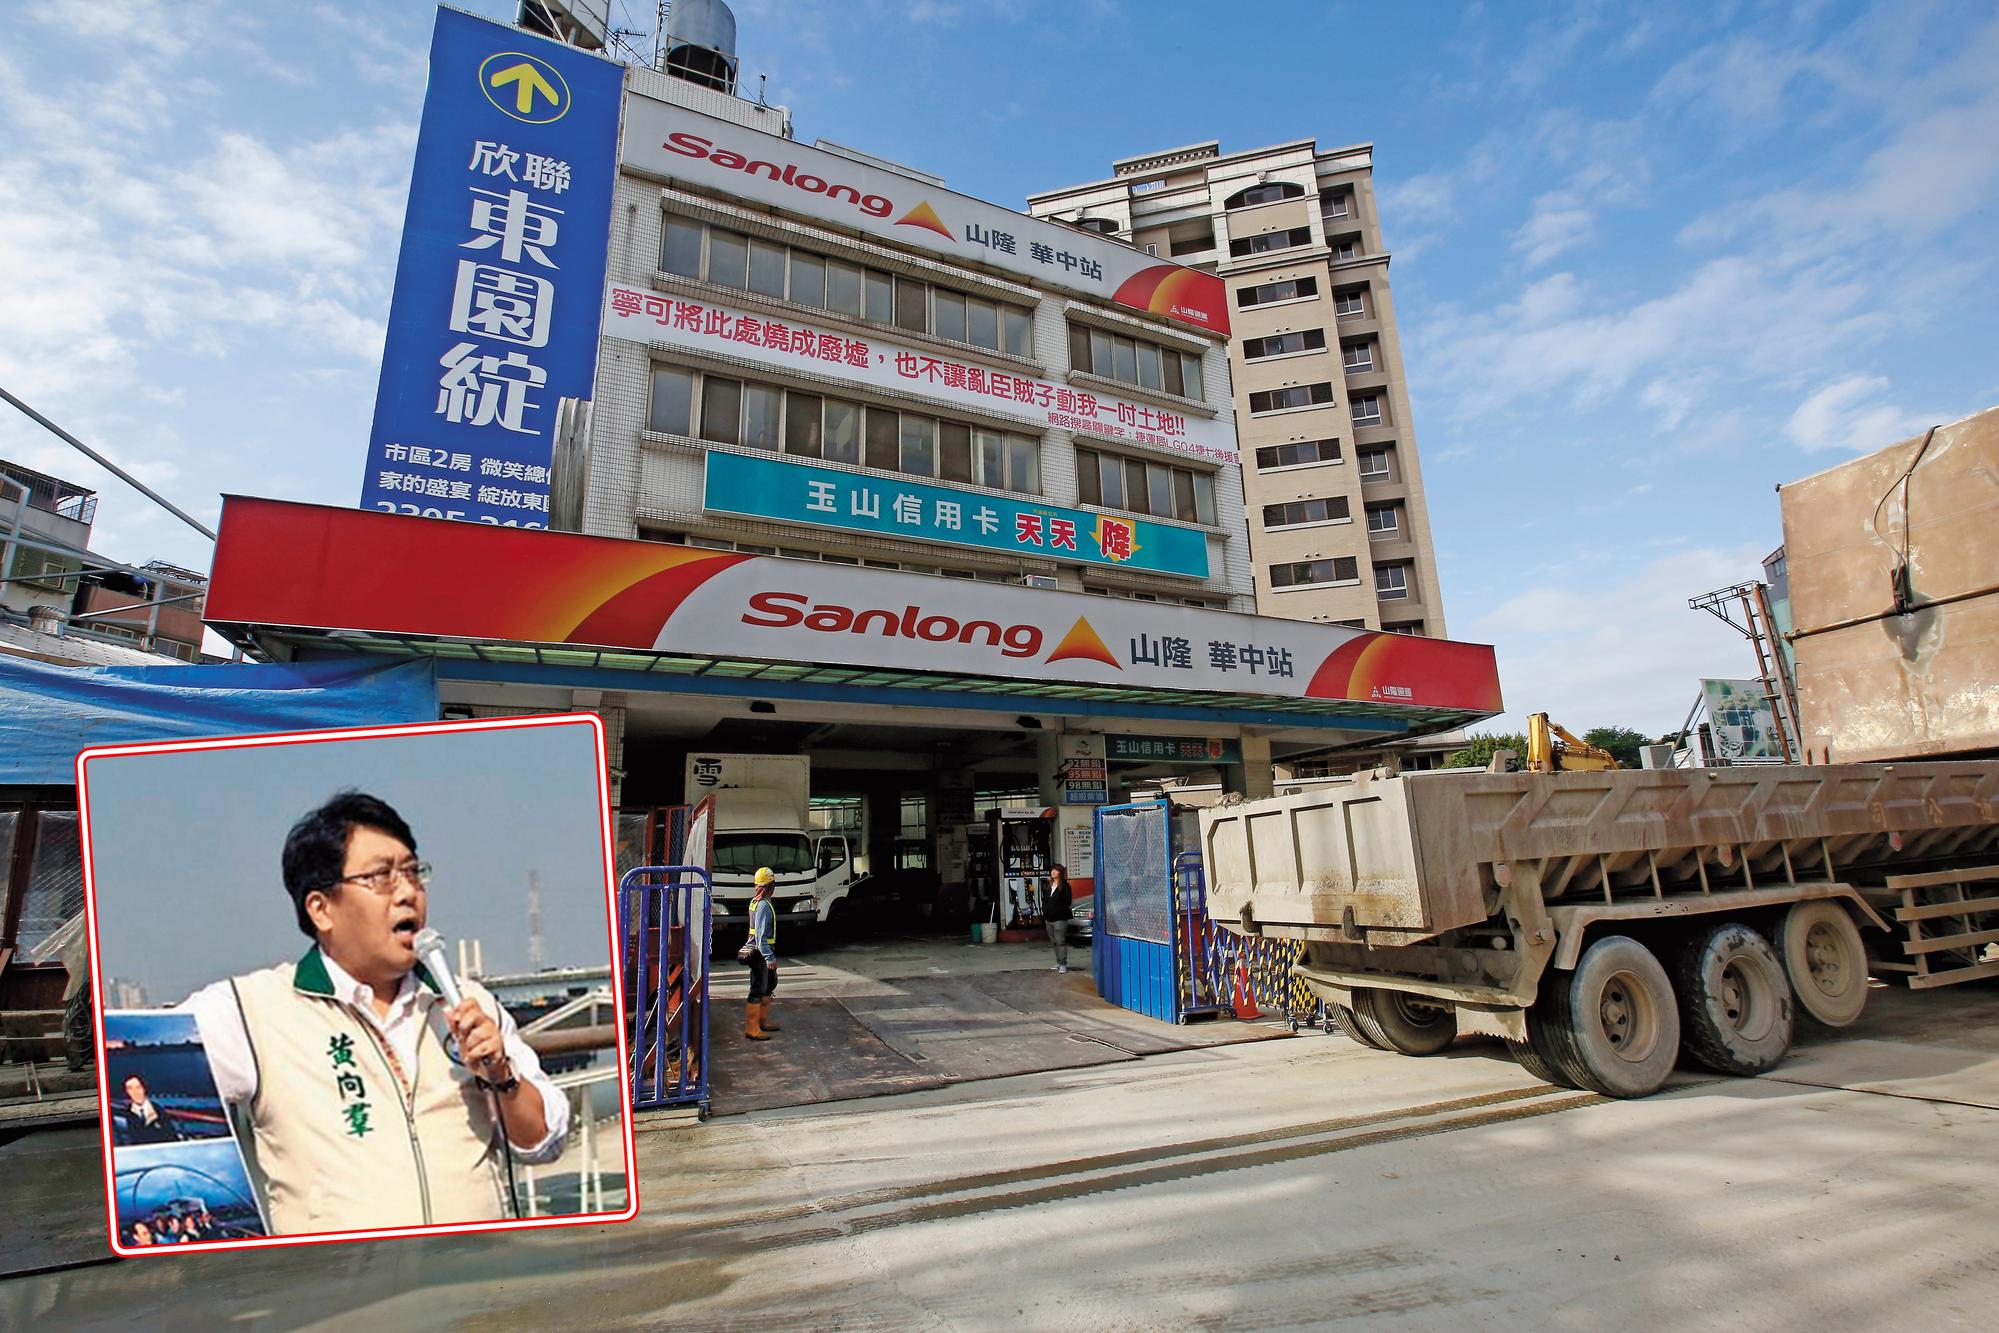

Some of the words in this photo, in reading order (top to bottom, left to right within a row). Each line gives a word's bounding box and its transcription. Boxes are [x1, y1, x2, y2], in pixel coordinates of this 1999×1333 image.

[468, 140, 571, 194] 欣聯
[662, 131, 894, 219] Sanlong
[965, 224, 1016, 256] 山隆
[1030, 242, 1103, 282] 華中站
[434, 186, 565, 436] 東園綻
[385, 443, 472, 472] 市區2房
[379, 471, 472, 500] 家的盛宴
[806, 480, 1000, 535] 玉山信用卡
[741, 591, 1043, 659] Sanlong
[1130, 633, 1192, 669] 山隆
[1208, 641, 1294, 679] 華中站
[694, 758, 722, 786] 雪
[1116, 740, 1176, 756] 玉山信用卡
